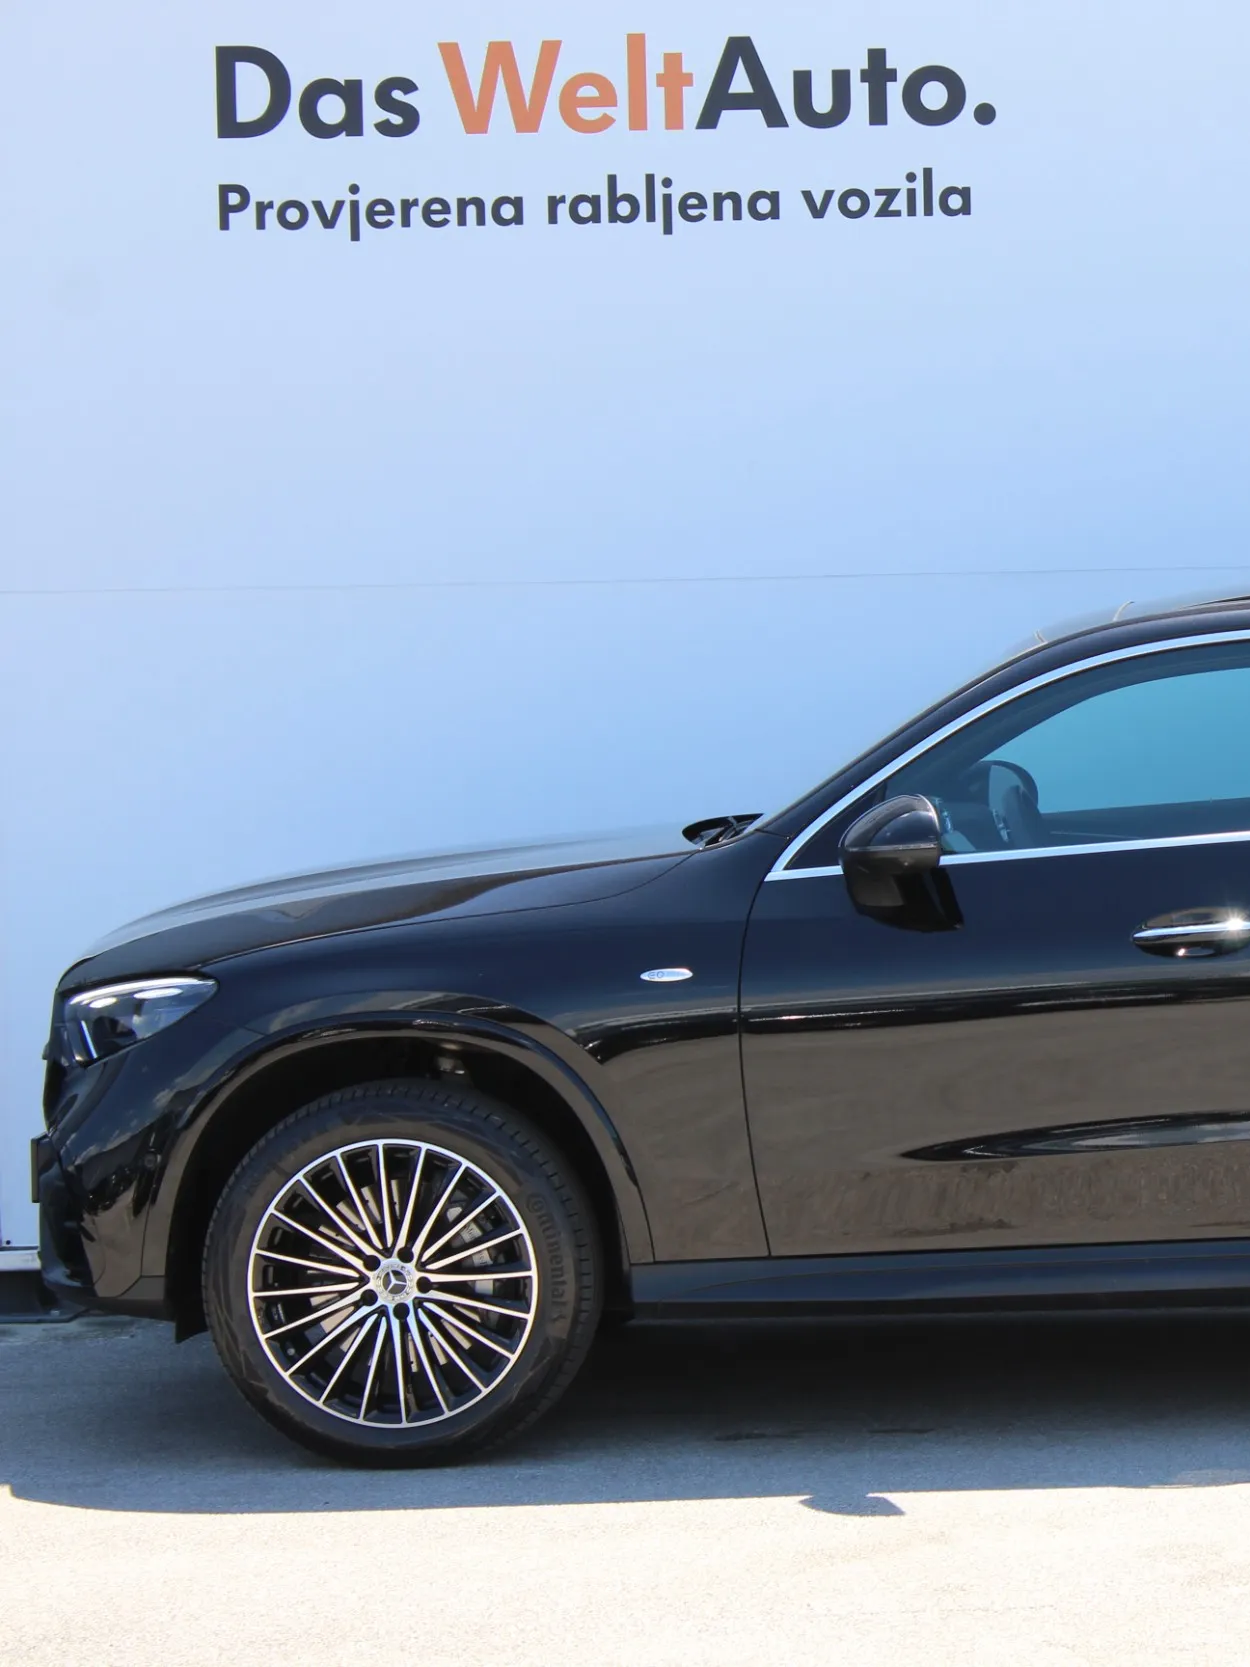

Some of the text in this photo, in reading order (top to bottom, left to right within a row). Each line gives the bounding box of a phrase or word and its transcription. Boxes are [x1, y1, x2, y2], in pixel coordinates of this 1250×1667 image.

[215, 32, 997, 140] Das WeltAuto.
[218, 167, 972, 242] Provjerena rabljena vozila
[525, 1193, 568, 1307] Continental
